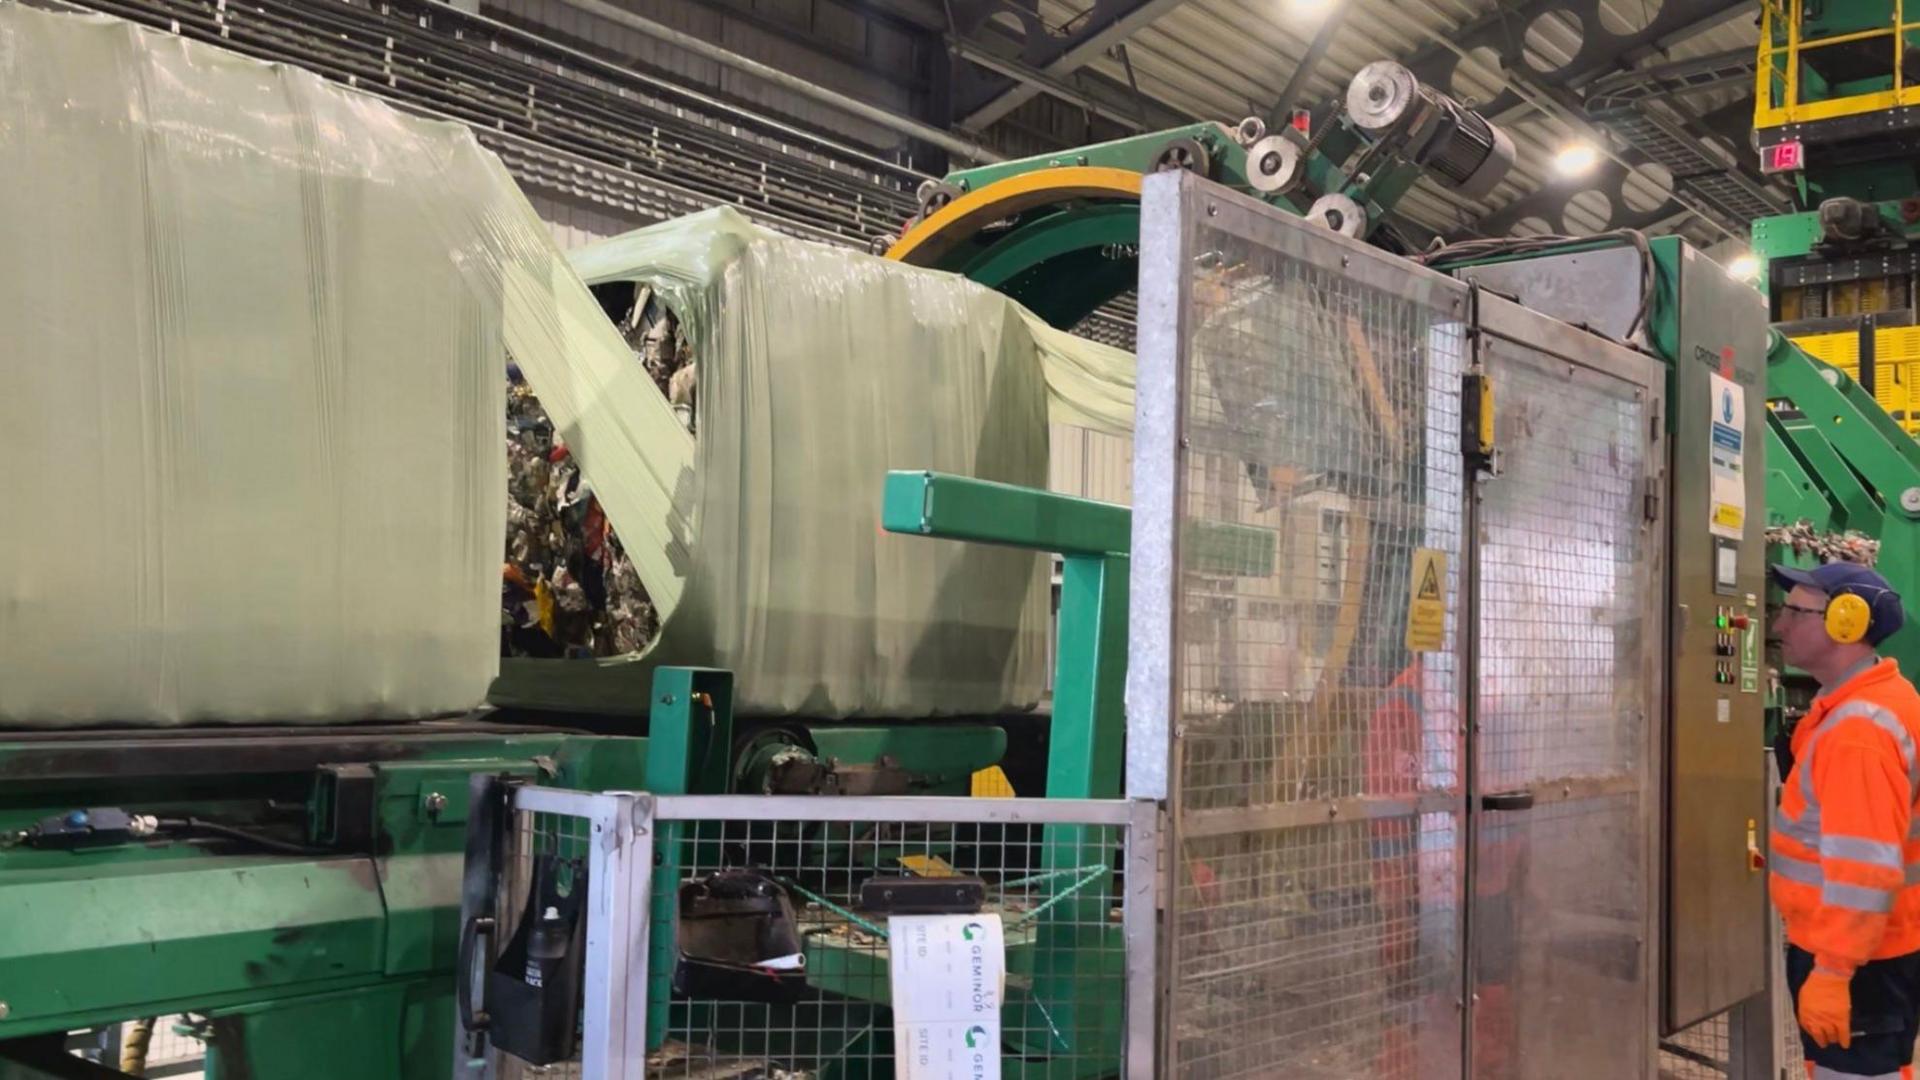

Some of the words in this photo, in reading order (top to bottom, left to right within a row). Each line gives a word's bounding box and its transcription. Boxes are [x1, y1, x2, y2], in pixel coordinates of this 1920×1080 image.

[918, 947, 928, 958] ID
[971, 945, 984, 1013] GEMINOR
[919, 1028, 929, 1050] SITE
[919, 1053, 929, 1066] ID
